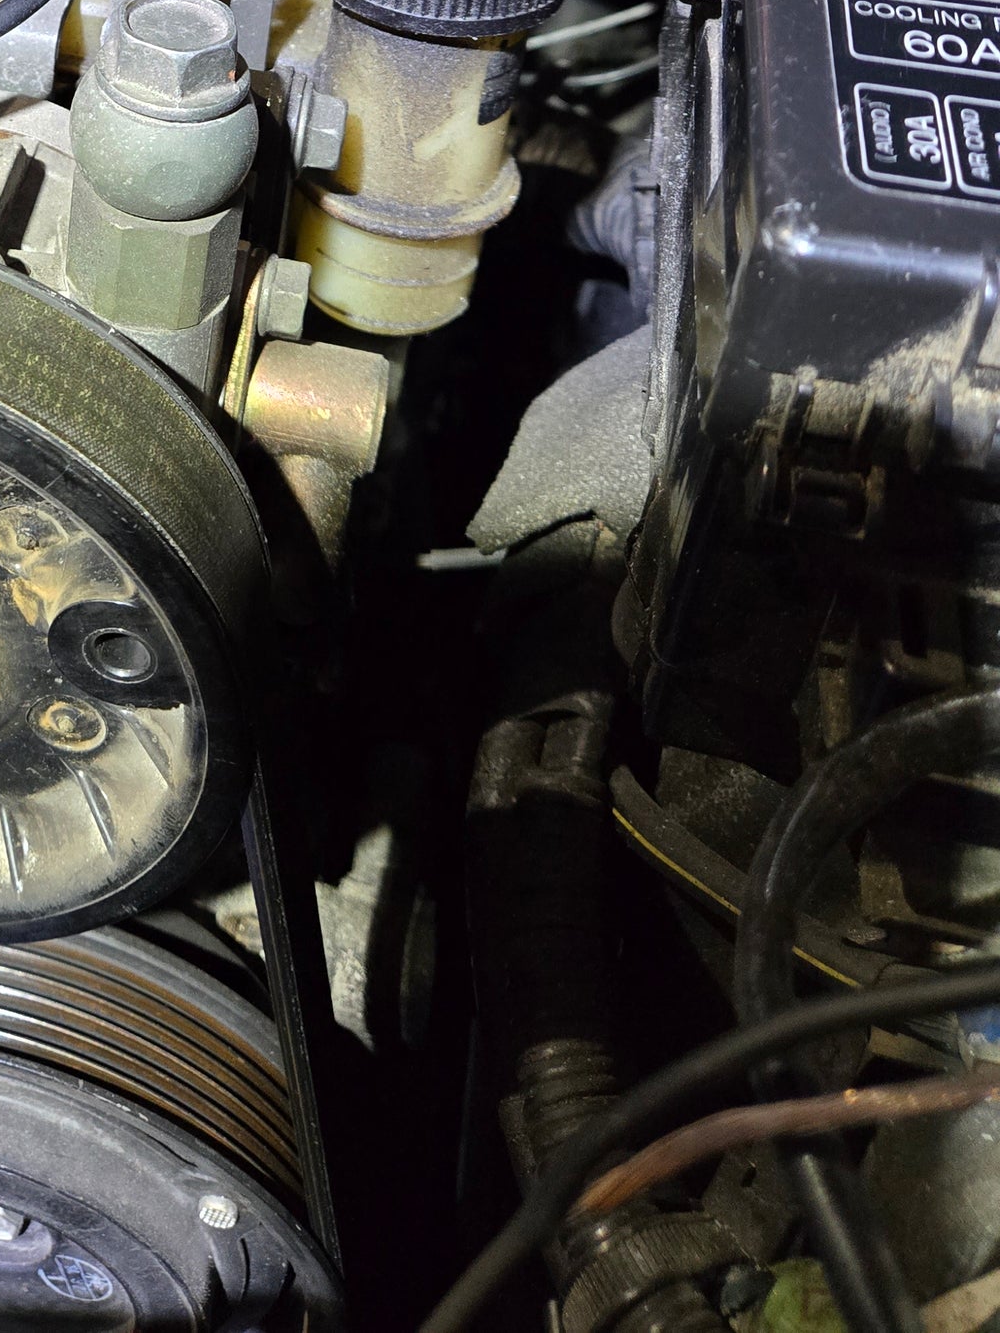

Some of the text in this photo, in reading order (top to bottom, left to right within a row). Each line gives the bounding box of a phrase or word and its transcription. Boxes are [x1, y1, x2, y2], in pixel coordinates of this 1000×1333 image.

[854, 0, 982, 30] COOLING
[903, 29, 1000, 65] 60A
[904, 115, 941, 164] 30A
